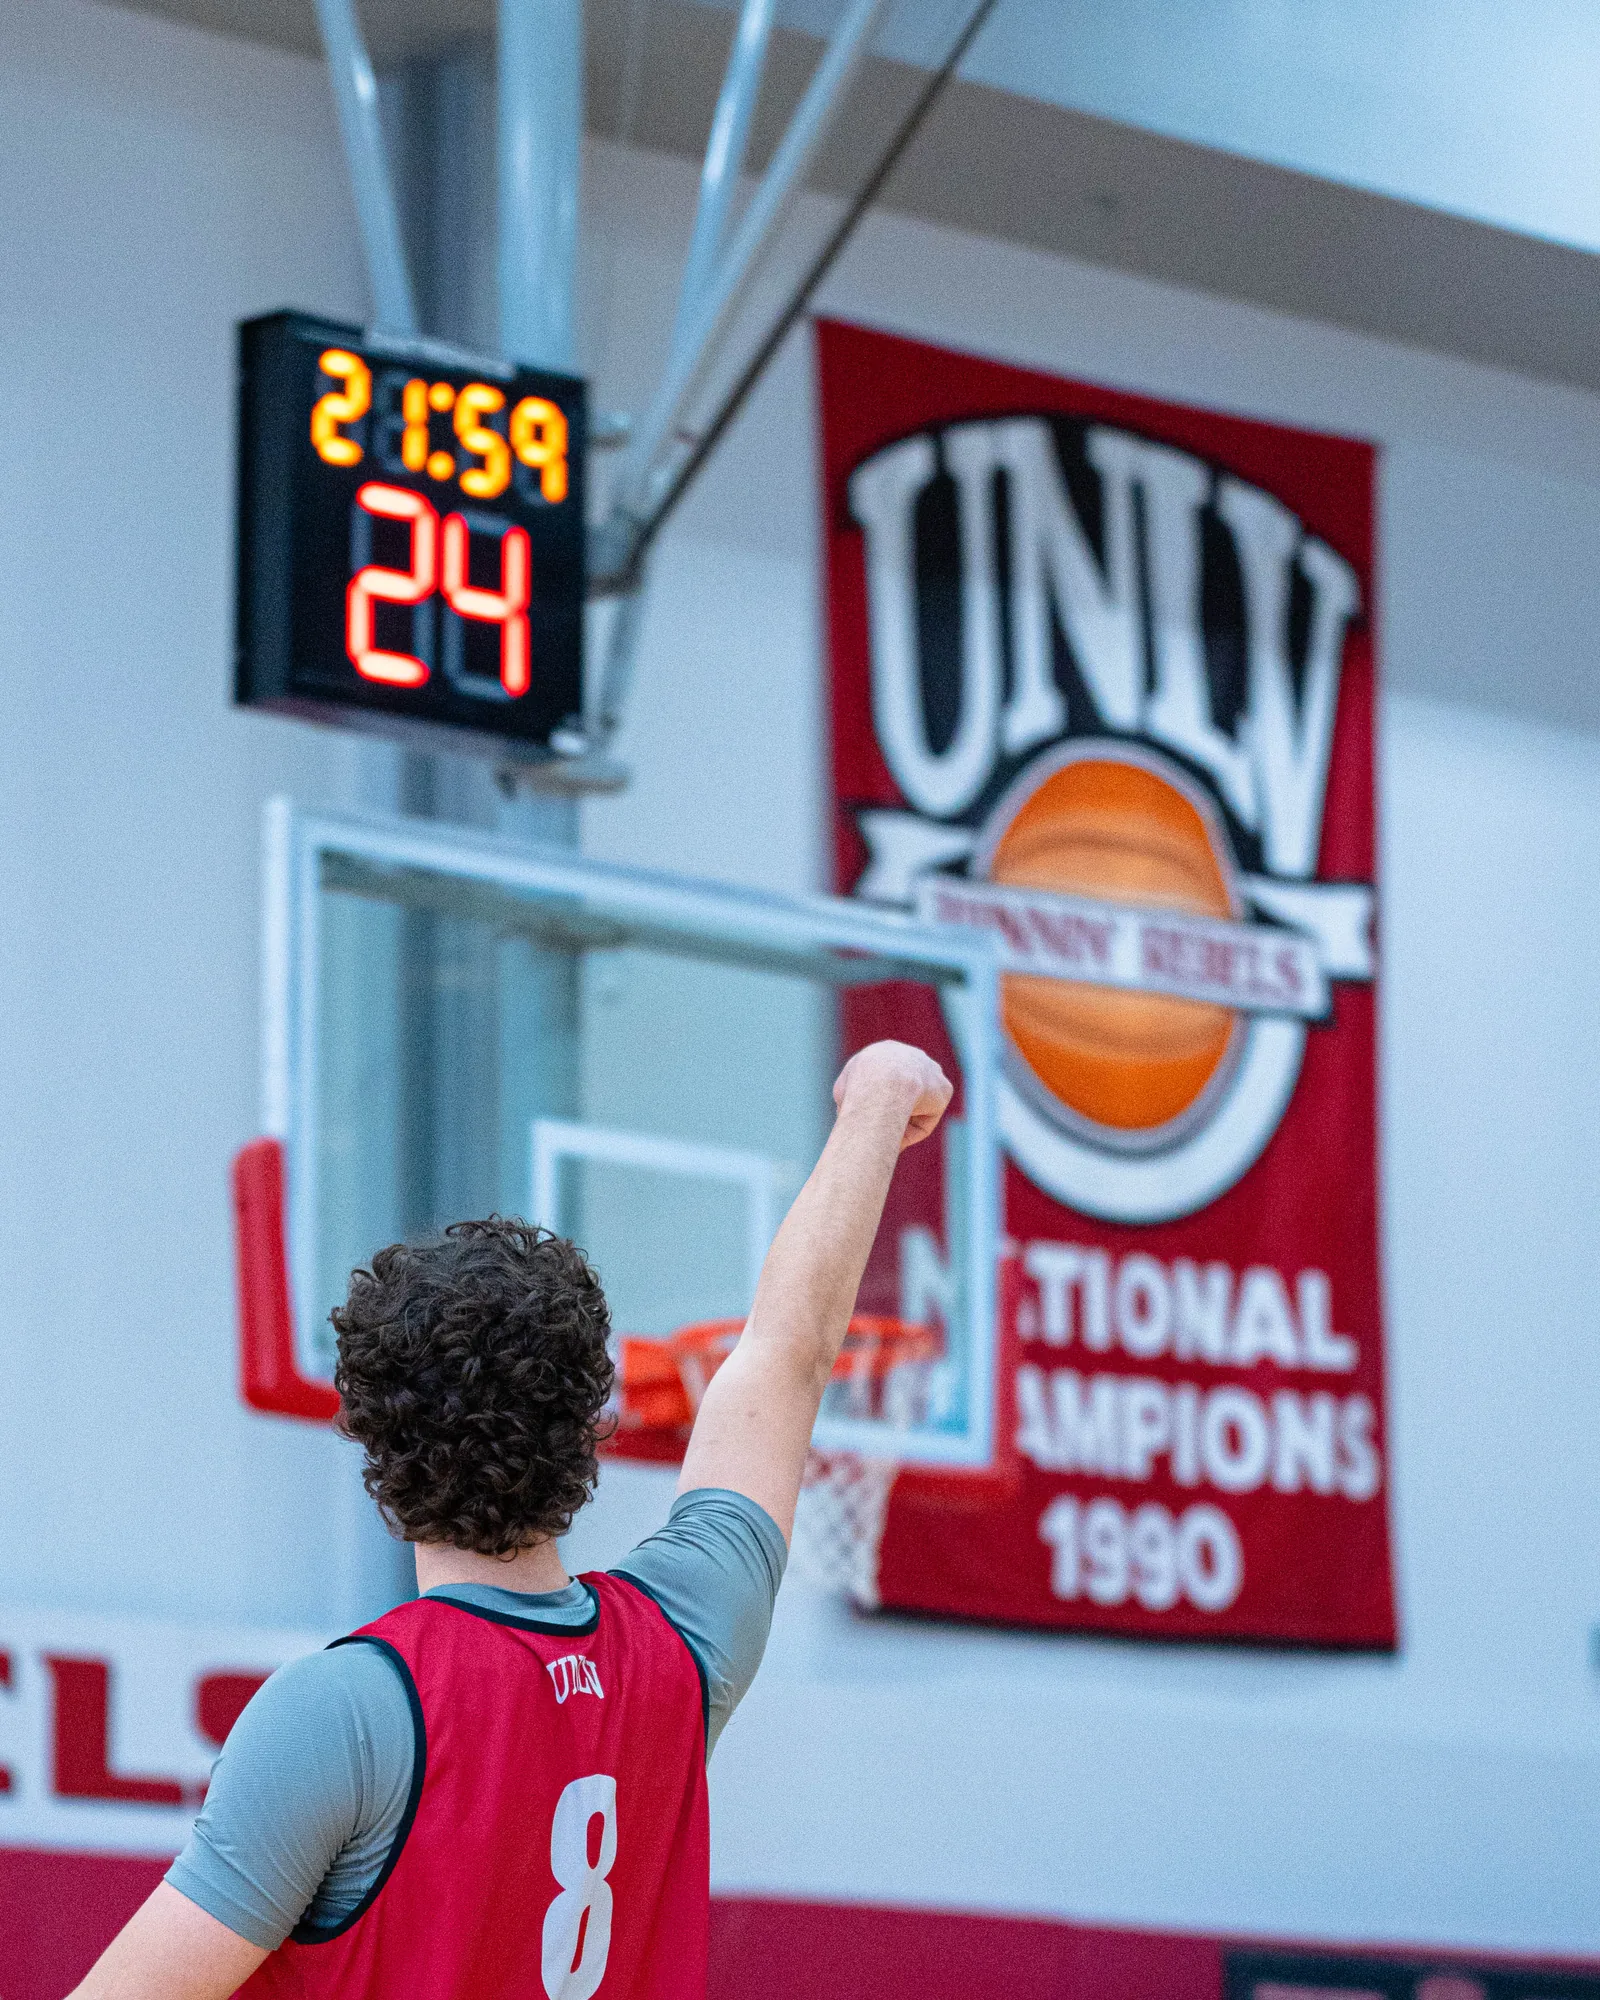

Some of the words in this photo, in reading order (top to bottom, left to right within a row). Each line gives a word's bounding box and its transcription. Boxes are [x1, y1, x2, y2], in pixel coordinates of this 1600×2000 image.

[310, 348, 569, 504] 21:59
[345, 480, 532, 698] 24
[846, 413, 1362, 879] UNLV
[902, 1224, 1360, 1374] NTIONAL
[1014, 1362, 1381, 1503] AMPIONS
[1038, 1492, 1244, 1612] 1990
[541, 1773, 617, 2000] 8
